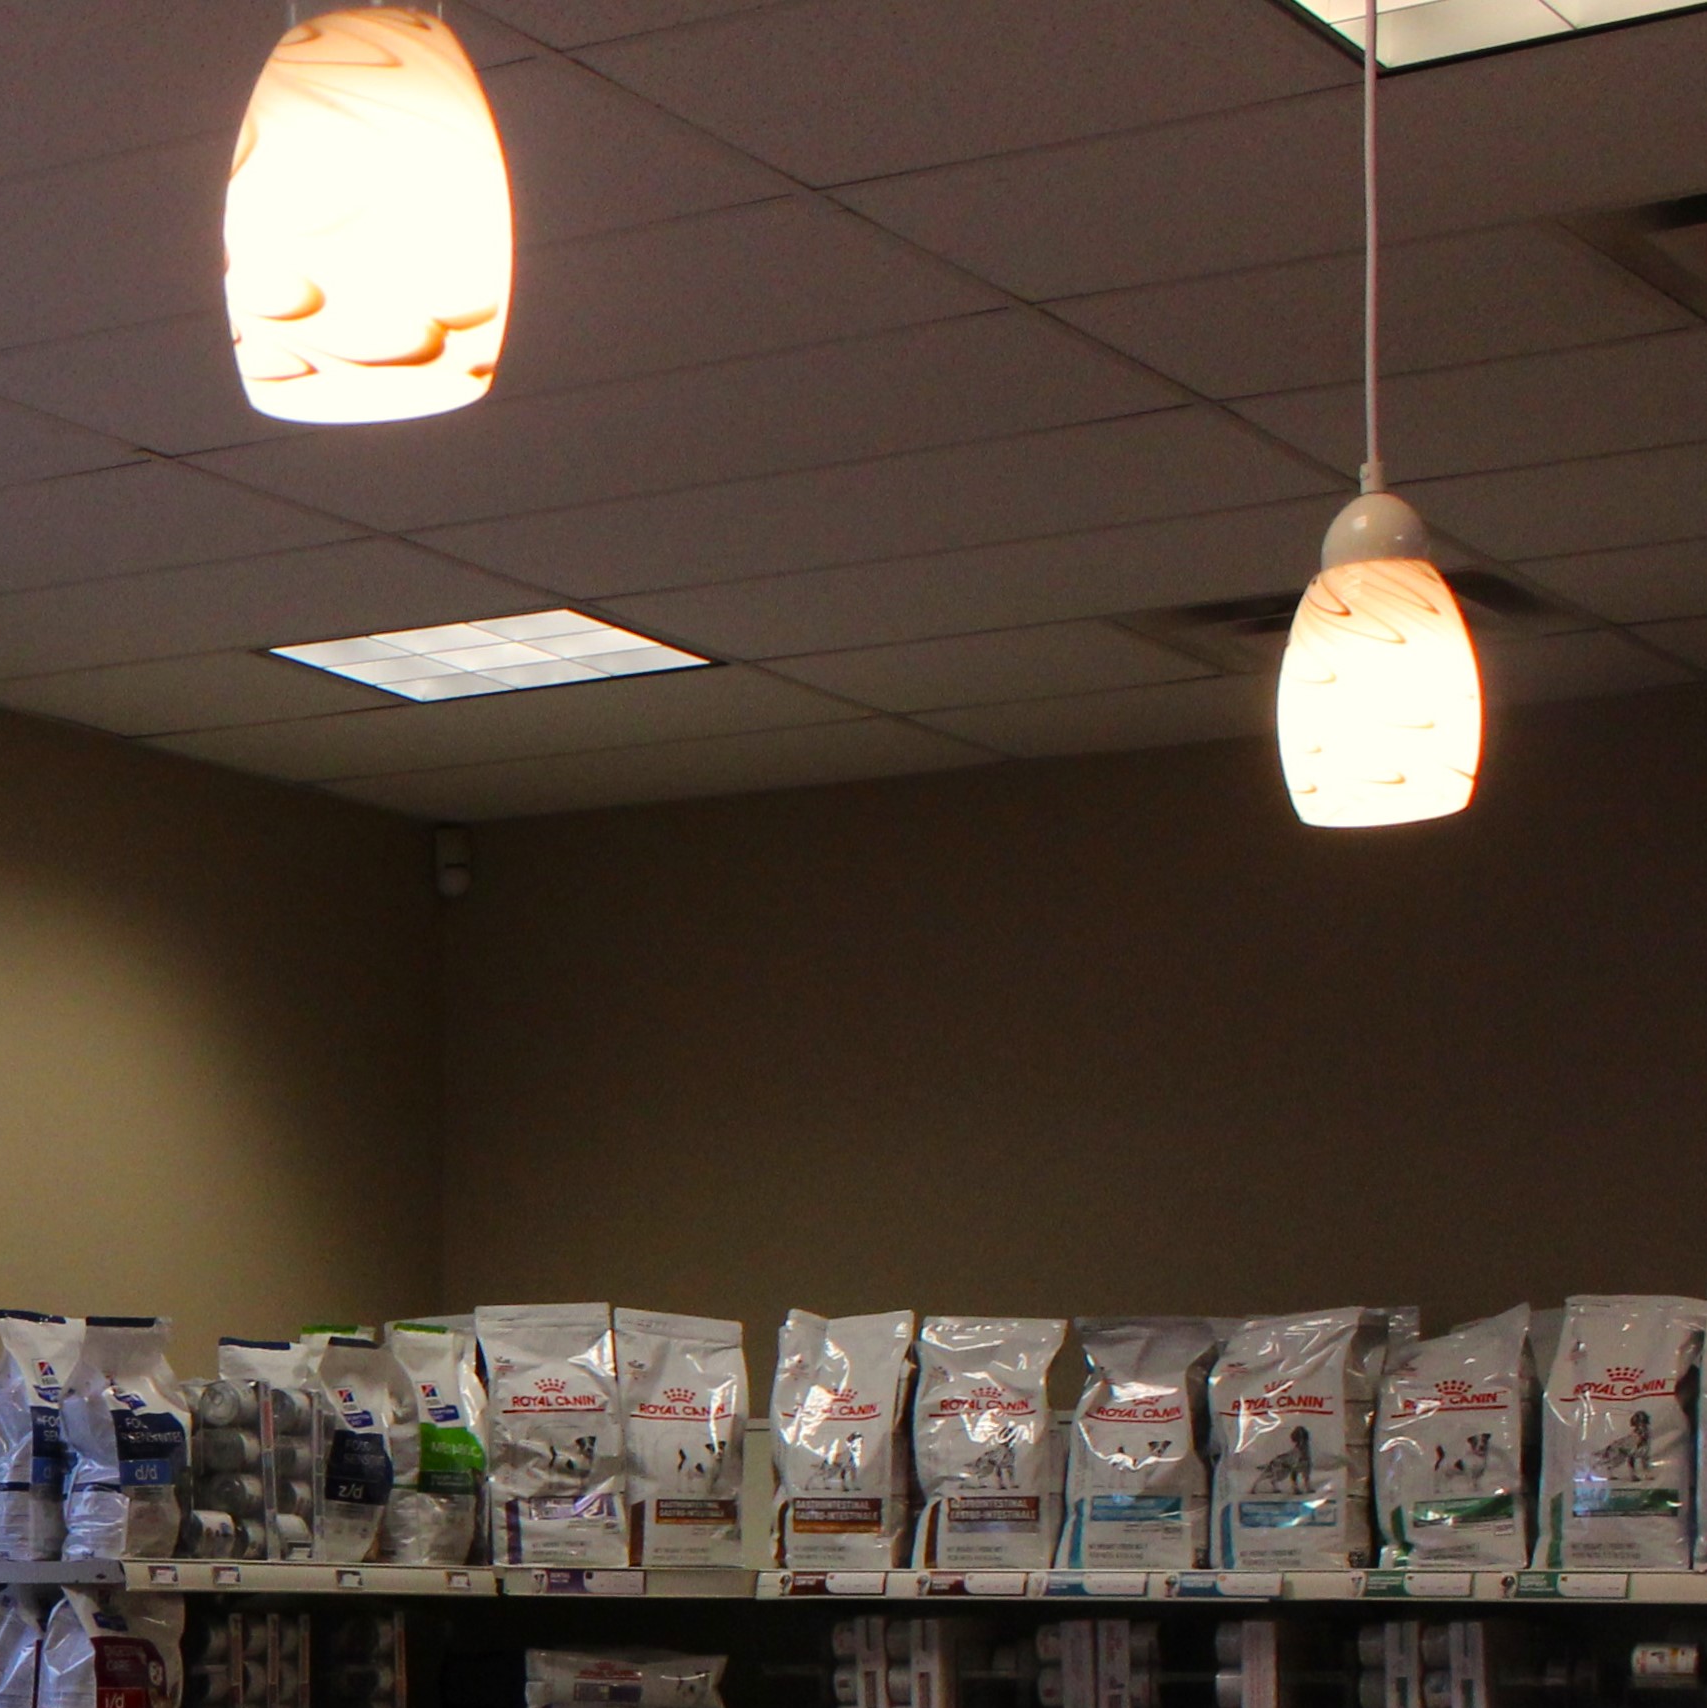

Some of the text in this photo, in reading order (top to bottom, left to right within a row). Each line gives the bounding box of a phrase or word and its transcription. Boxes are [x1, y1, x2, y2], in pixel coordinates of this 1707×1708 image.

[1574, 1379, 1666, 1398] ROYAL CANIN
[511, 1393, 596, 1407] ROYAL CANIN
[939, 1398, 1029, 1411] ROYAL CANIN
[1277, 1395, 1324, 1409] CANIN
[1450, 1392, 1497, 1405] CANIN
[638, 1403, 681, 1416] ROYAL
[840, 1402, 877, 1415] CANIN
[1097, 1406, 1182, 1418] ROYAL CANIN
[136, 1464, 159, 1481] d/d
[337, 1483, 365, 1500] z/d
